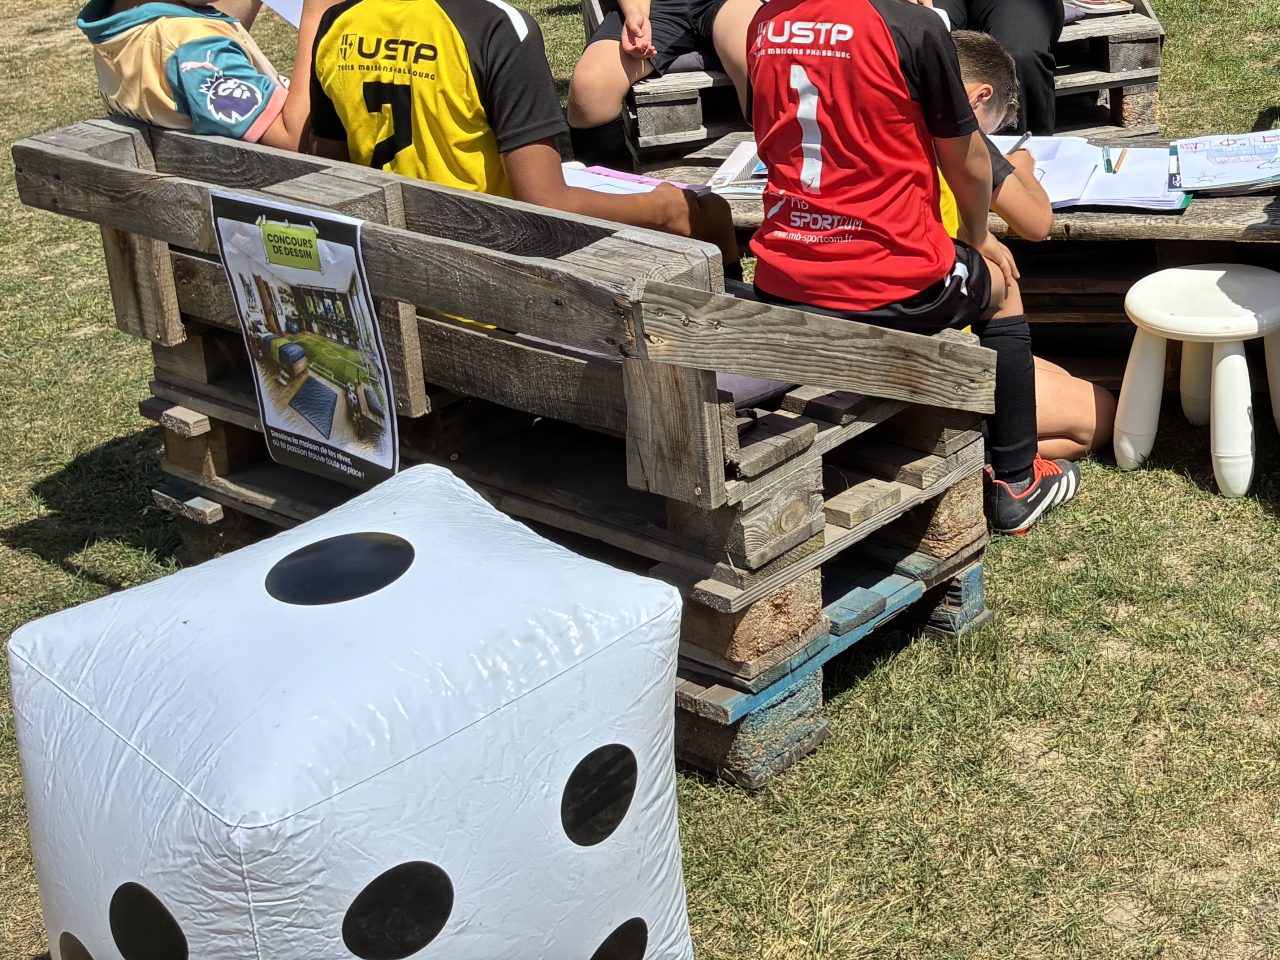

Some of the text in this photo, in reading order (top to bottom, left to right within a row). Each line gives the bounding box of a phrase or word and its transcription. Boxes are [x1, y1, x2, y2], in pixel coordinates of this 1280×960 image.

[767, 20, 854, 45] USTP
[357, 36, 438, 64] USTP
[363, 81, 412, 169] 7
[790, 64, 823, 195] 1
[267, 233, 313, 248] CONCOURS
[273, 245, 312, 259] DE DESSIN
[287, 444, 307, 456] passion
[326, 457, 340, 469] toute
[299, 440, 319, 451] maison
